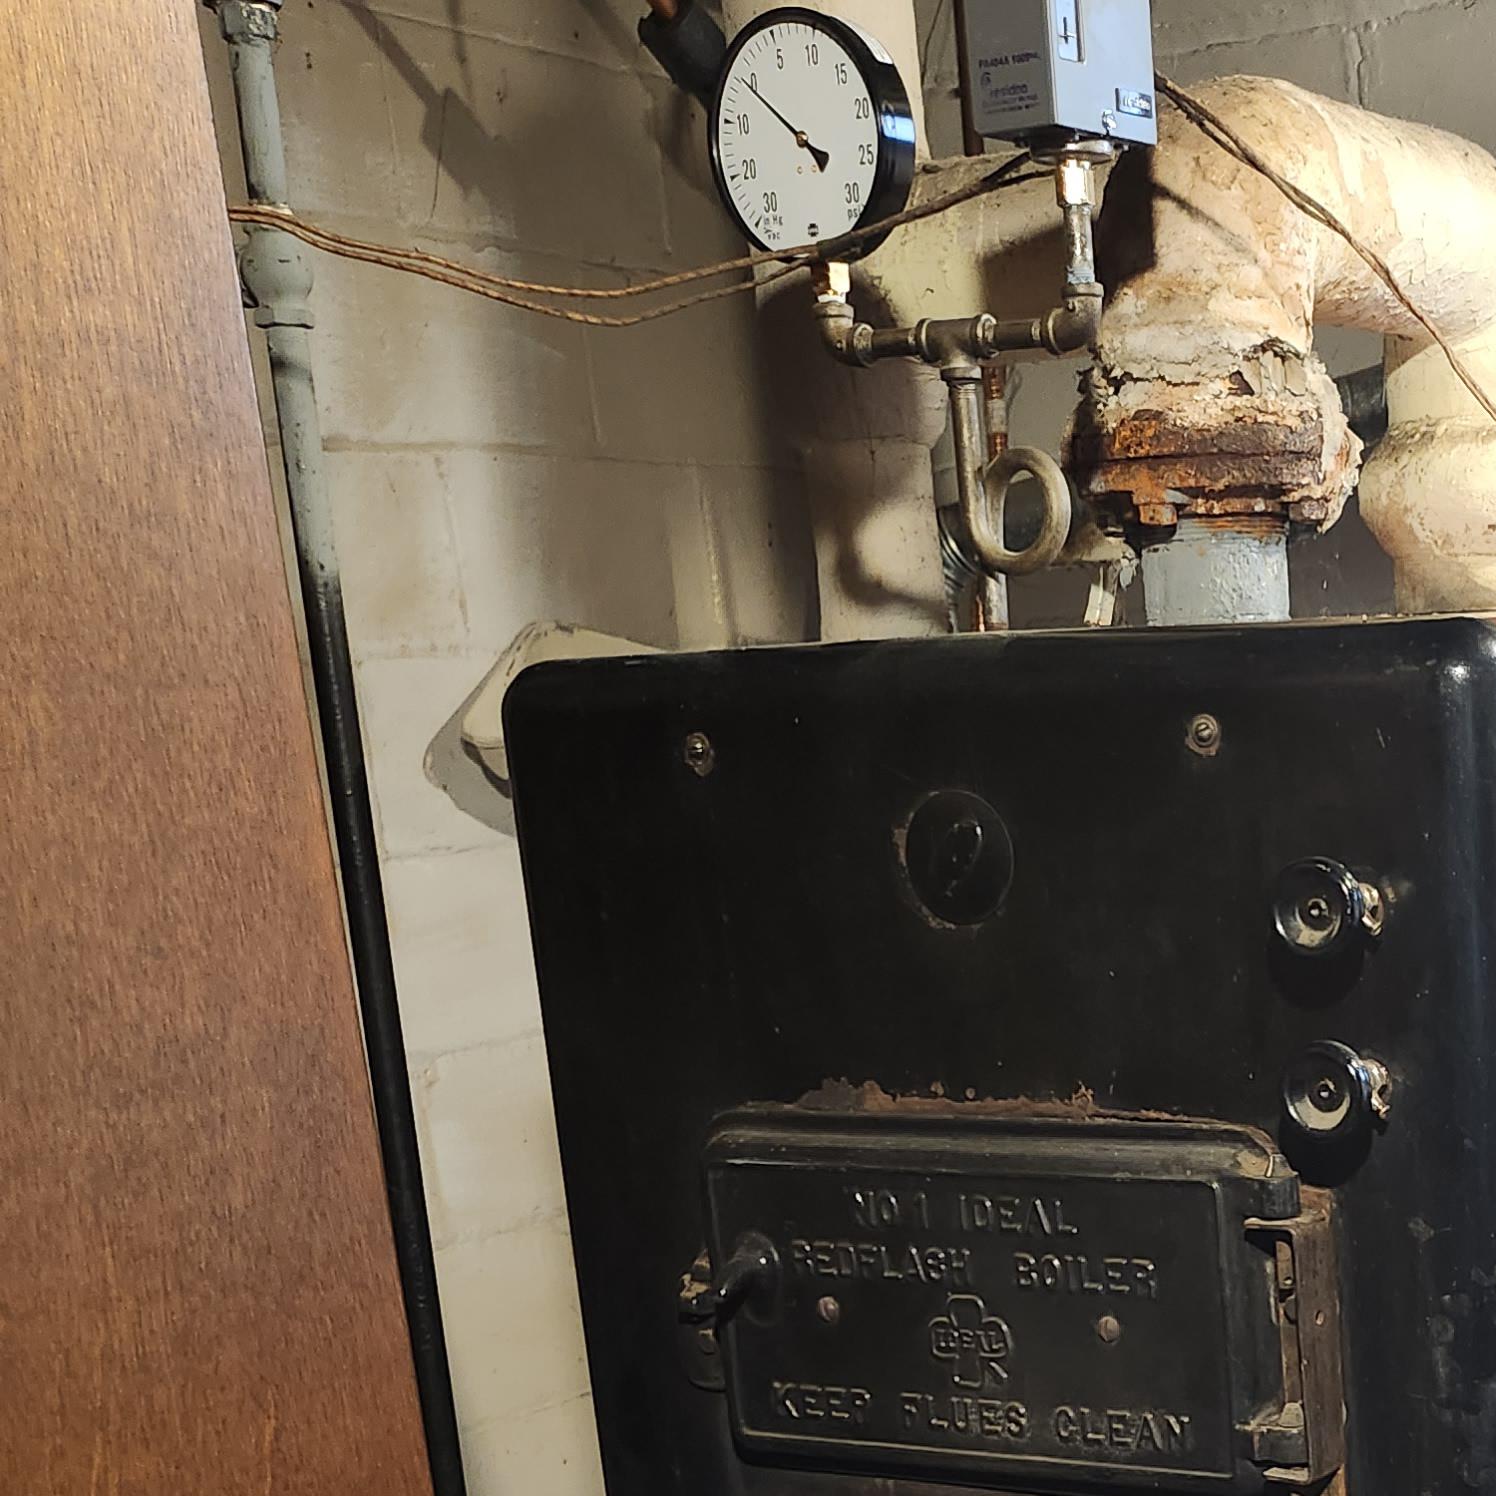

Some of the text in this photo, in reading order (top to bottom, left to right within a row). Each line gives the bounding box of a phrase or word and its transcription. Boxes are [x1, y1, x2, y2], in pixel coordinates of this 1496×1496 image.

[776, 48, 784, 70] 5
[805, 43, 819, 66] 10
[750, 73, 758, 92] 0
[835, 62, 848, 85] 15
[855, 97, 870, 119] 20
[737, 114, 750, 135] 10
[858, 144, 874, 165] 25
[742, 158, 757, 181] 20
[763, 191, 778, 213] 30
[844, 182, 860, 204] 30
[846, 1188, 898, 1228] NO
[957, 1193, 1080, 1234] IDEAL
[790, 1238, 1158, 1298] REDFLASH BOILER
[772, 1386, 1193, 1450] KEEP FLUES CLEAN
